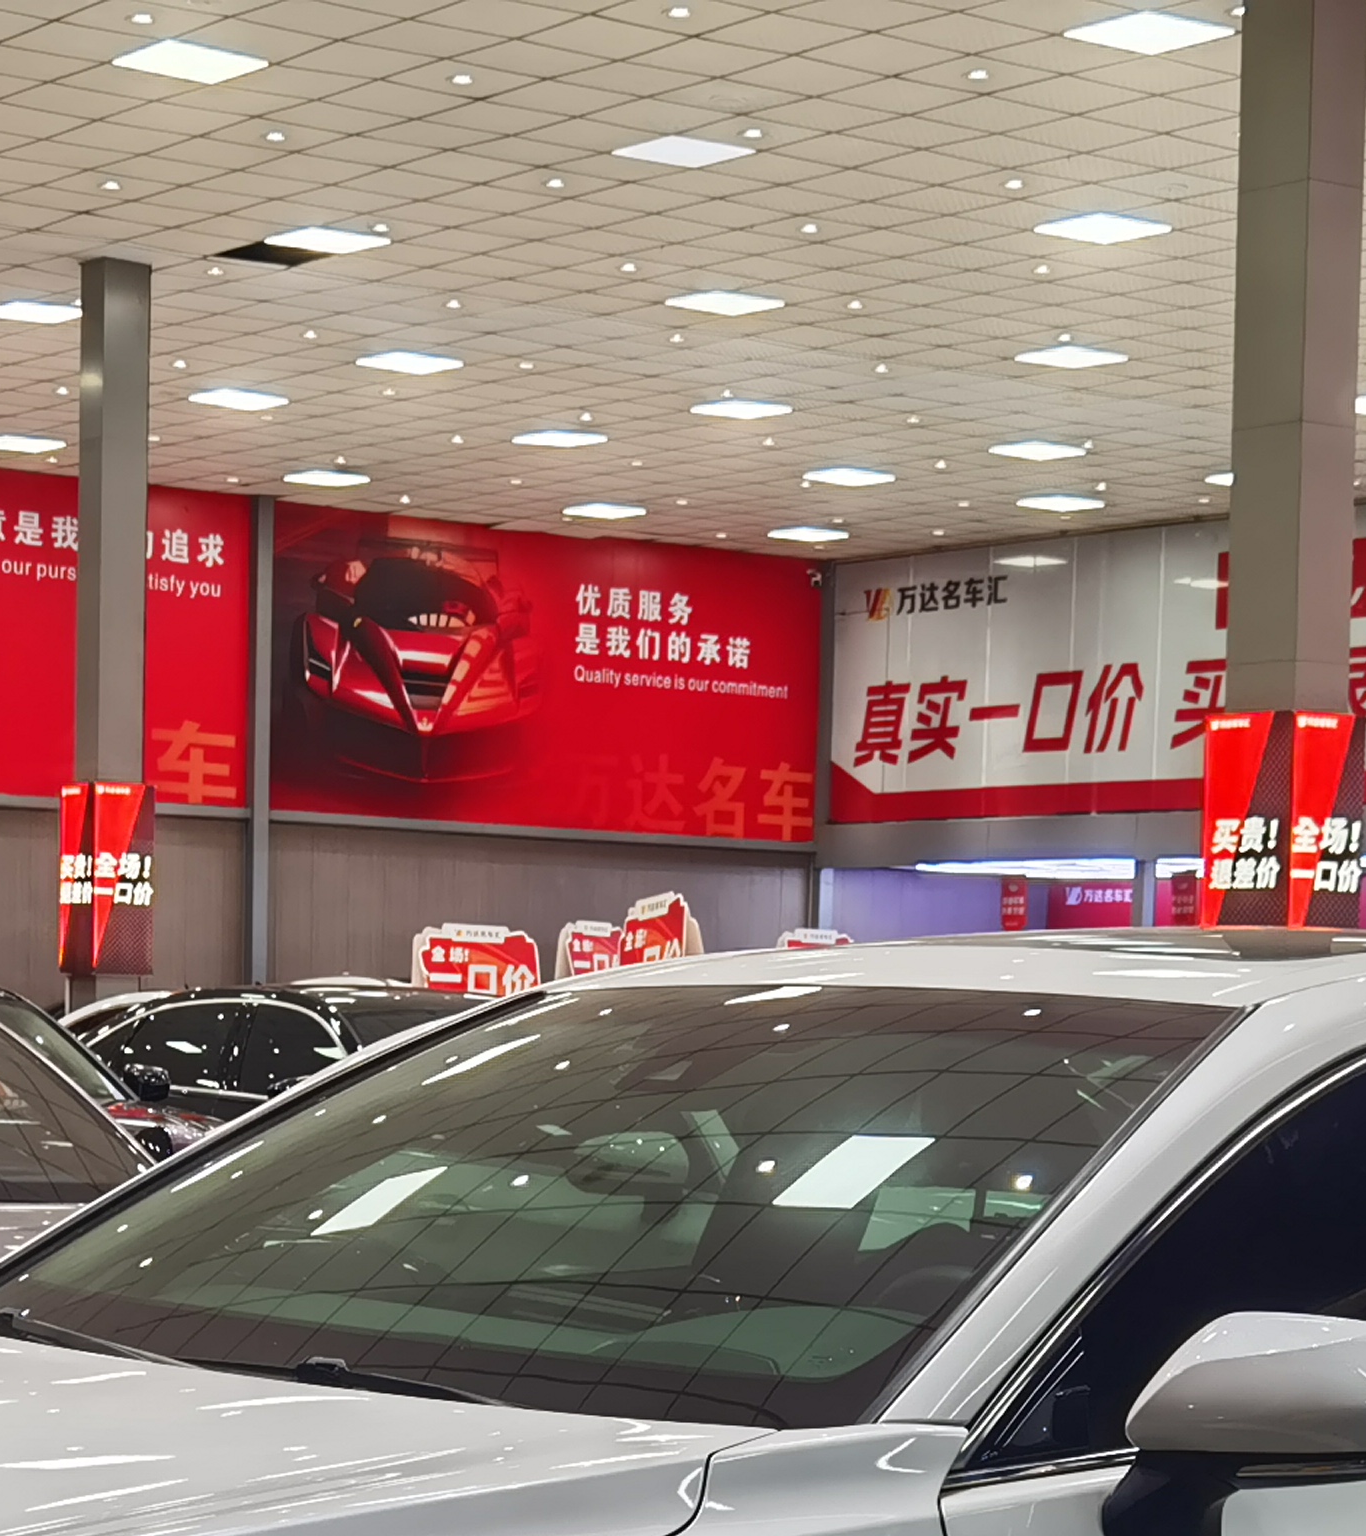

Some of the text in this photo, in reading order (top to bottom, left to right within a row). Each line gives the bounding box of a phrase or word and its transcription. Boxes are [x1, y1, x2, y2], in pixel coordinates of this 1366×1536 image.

[1, 559, 32, 577] our
[36, 562, 77, 581] purs
[147, 574, 185, 596] tisfy
[189, 580, 223, 599] you
[896, 575, 1009, 616] 万达名车汇
[575, 583, 693, 626] 优质服务
[575, 623, 751, 669] 是我们的承诺
[574, 665, 789, 700] Quality service is our commitment
[853, 662, 1144, 768] 真实一口价
[1291, 816, 1362, 855] 全场!
[94, 852, 152, 880] 全场!
[1290, 858, 1363, 894] 一口价
[94, 881, 154, 906] 一口价
[429, 964, 535, 997] 一口价
